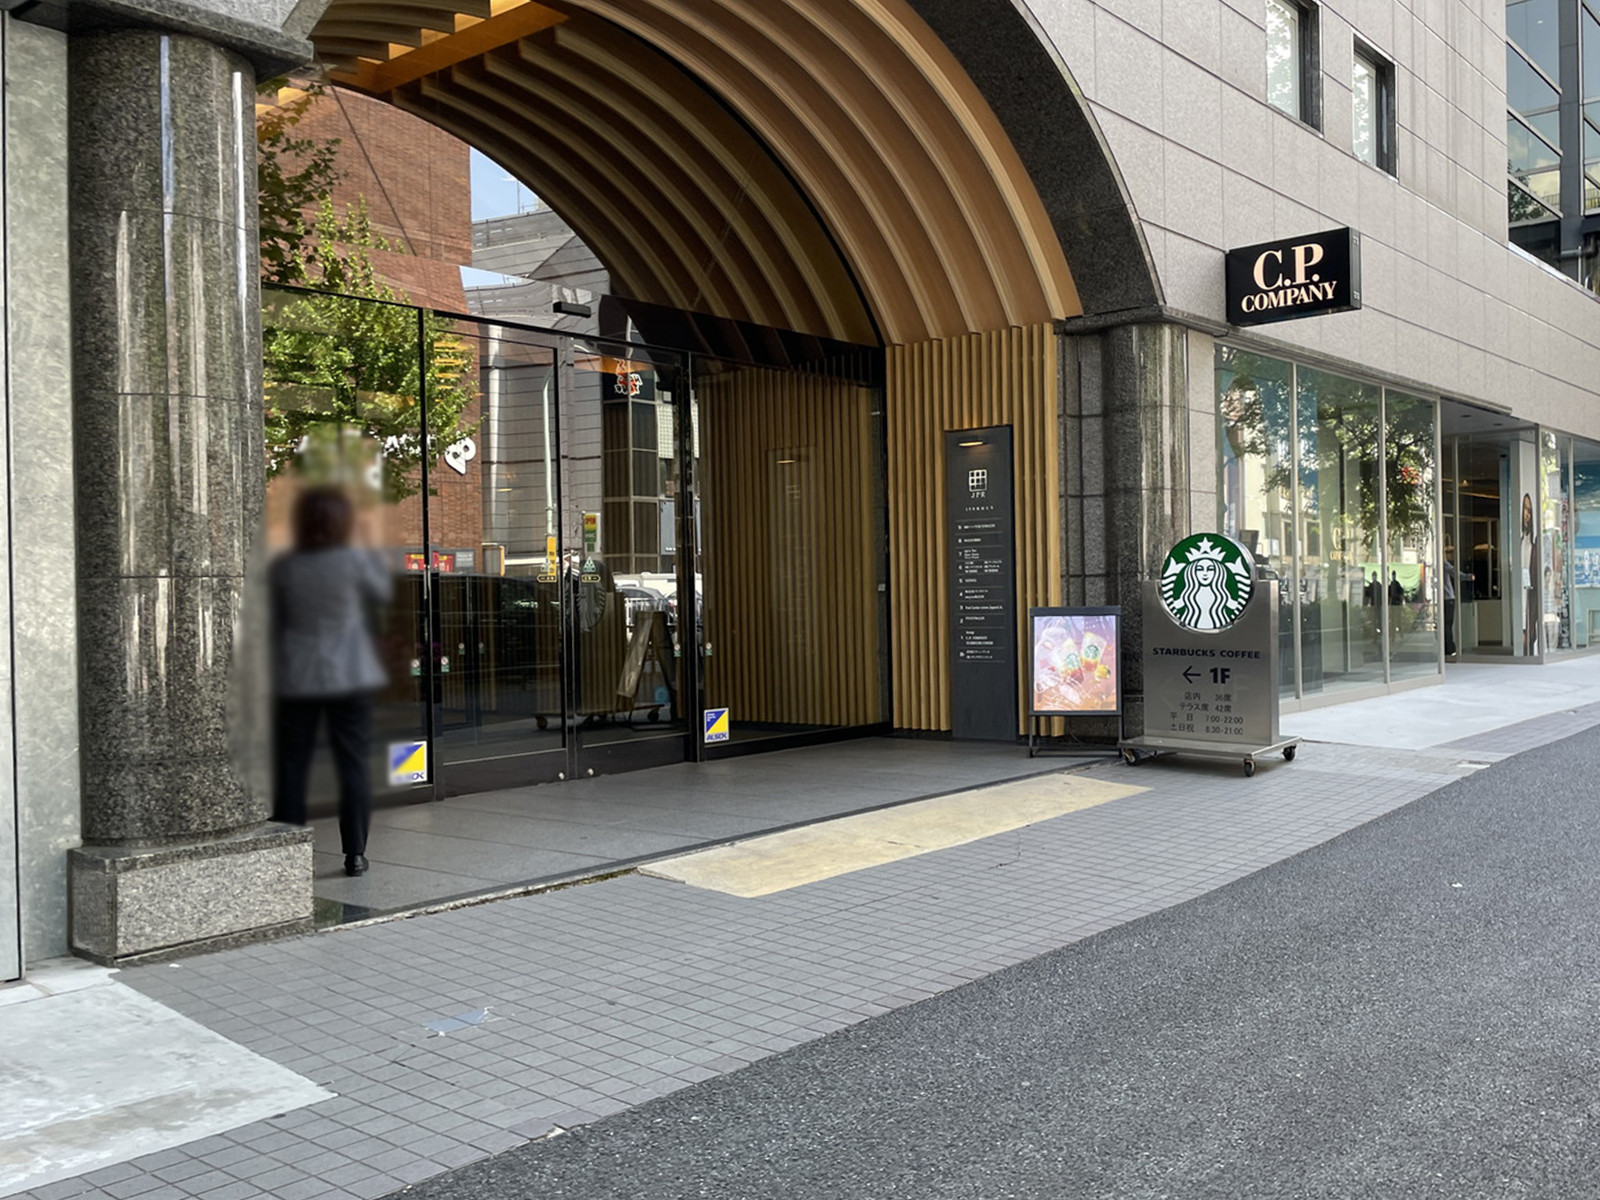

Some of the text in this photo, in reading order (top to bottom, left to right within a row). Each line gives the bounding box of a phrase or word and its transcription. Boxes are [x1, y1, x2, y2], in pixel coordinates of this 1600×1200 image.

[1253, 243, 1324, 291] C.P.
[1241, 281, 1337, 313] COMPANY
[1152, 647, 1261, 659] STARBUCKS COFFEE
[1209, 667, 1231, 684] 1F
